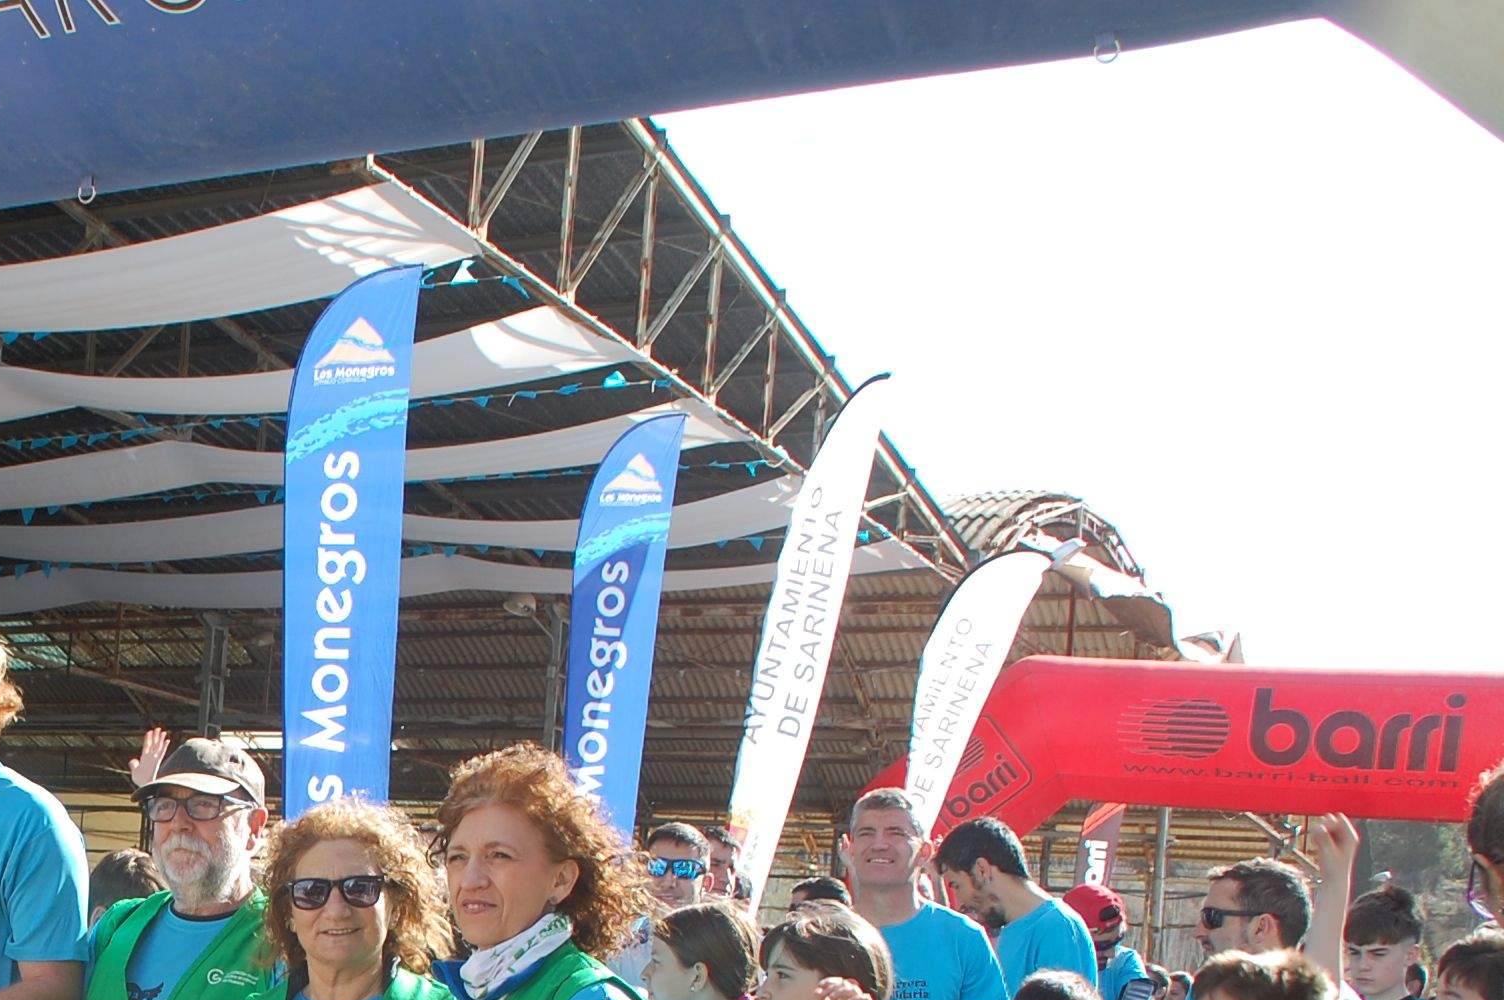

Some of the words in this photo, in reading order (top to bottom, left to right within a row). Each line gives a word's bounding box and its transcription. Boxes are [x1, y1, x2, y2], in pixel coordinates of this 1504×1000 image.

[335, 366, 395, 379] Monegros
[299, 451, 368, 752] Monegros
[575, 559, 630, 800] Monegros
[776, 691, 809, 739] DE
[1250, 687, 1468, 772] barri
